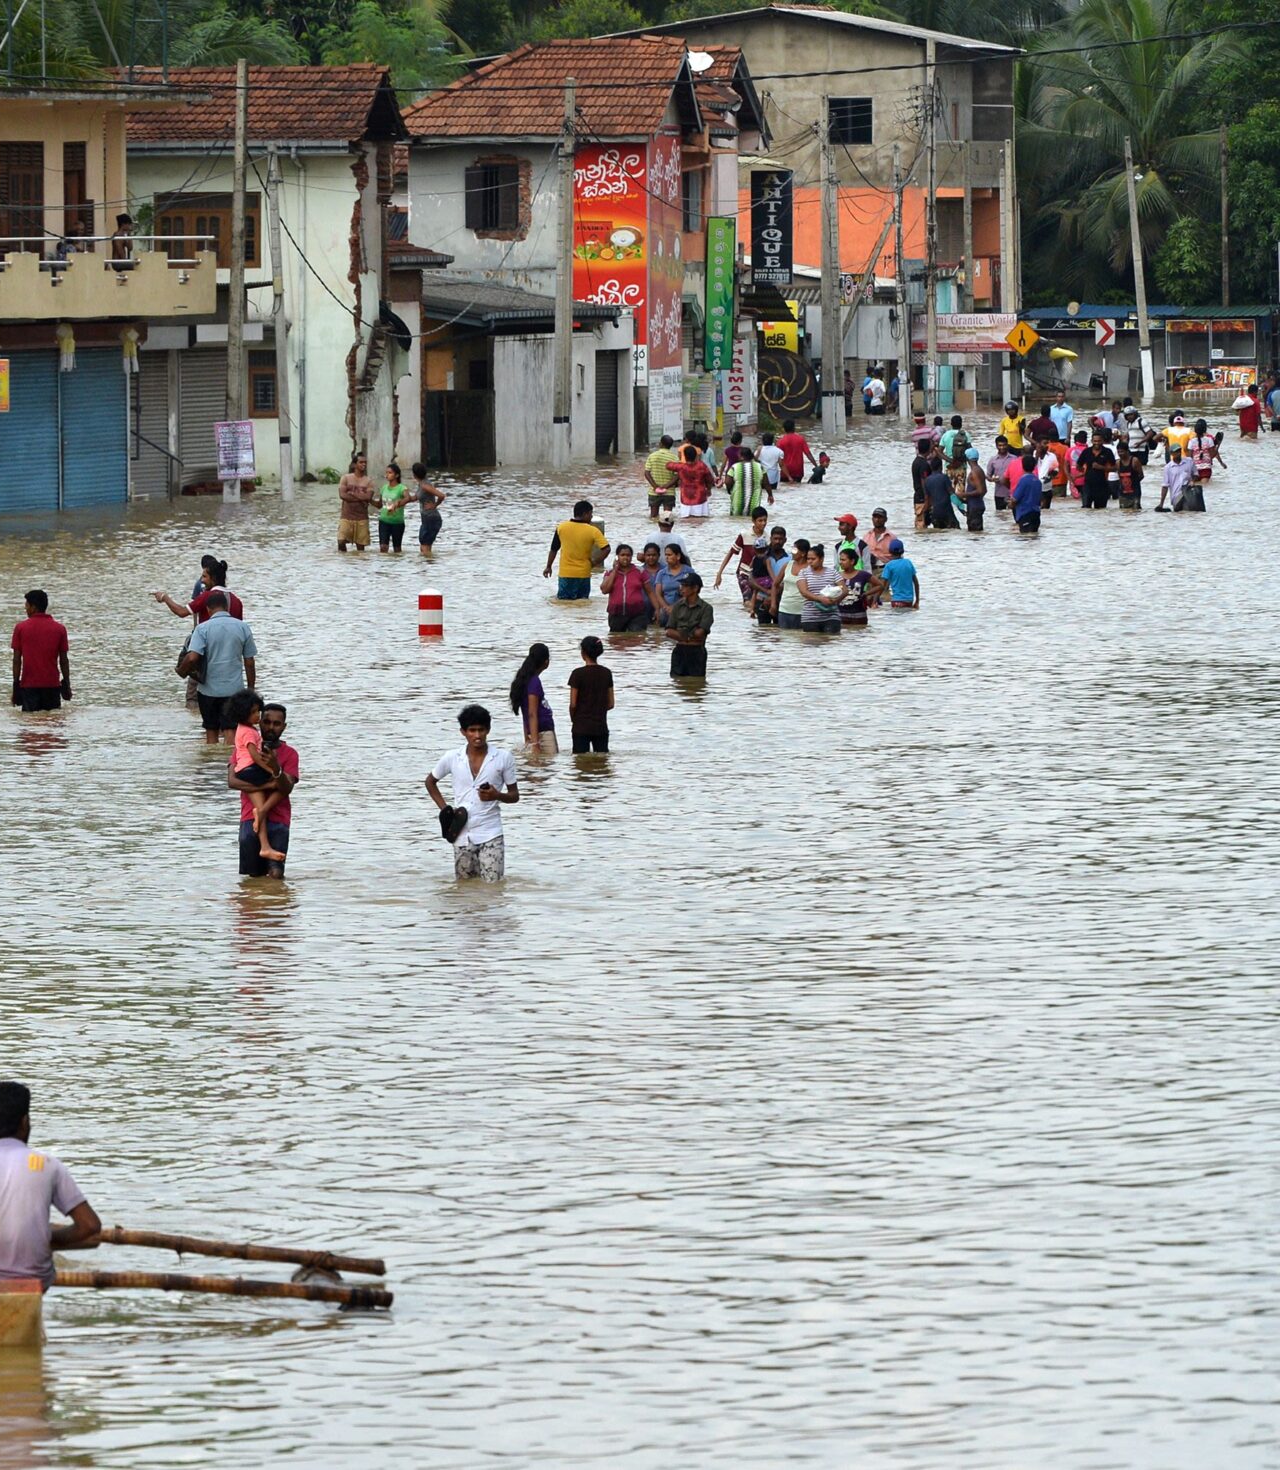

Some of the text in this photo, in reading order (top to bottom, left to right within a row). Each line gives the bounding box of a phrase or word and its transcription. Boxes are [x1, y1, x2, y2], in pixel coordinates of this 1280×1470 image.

[761, 174, 783, 267] ANTIQUE
[951, 314, 984, 326] Granite
[988, 314, 1016, 325] World
[1209, 367, 1251, 386] BITE
